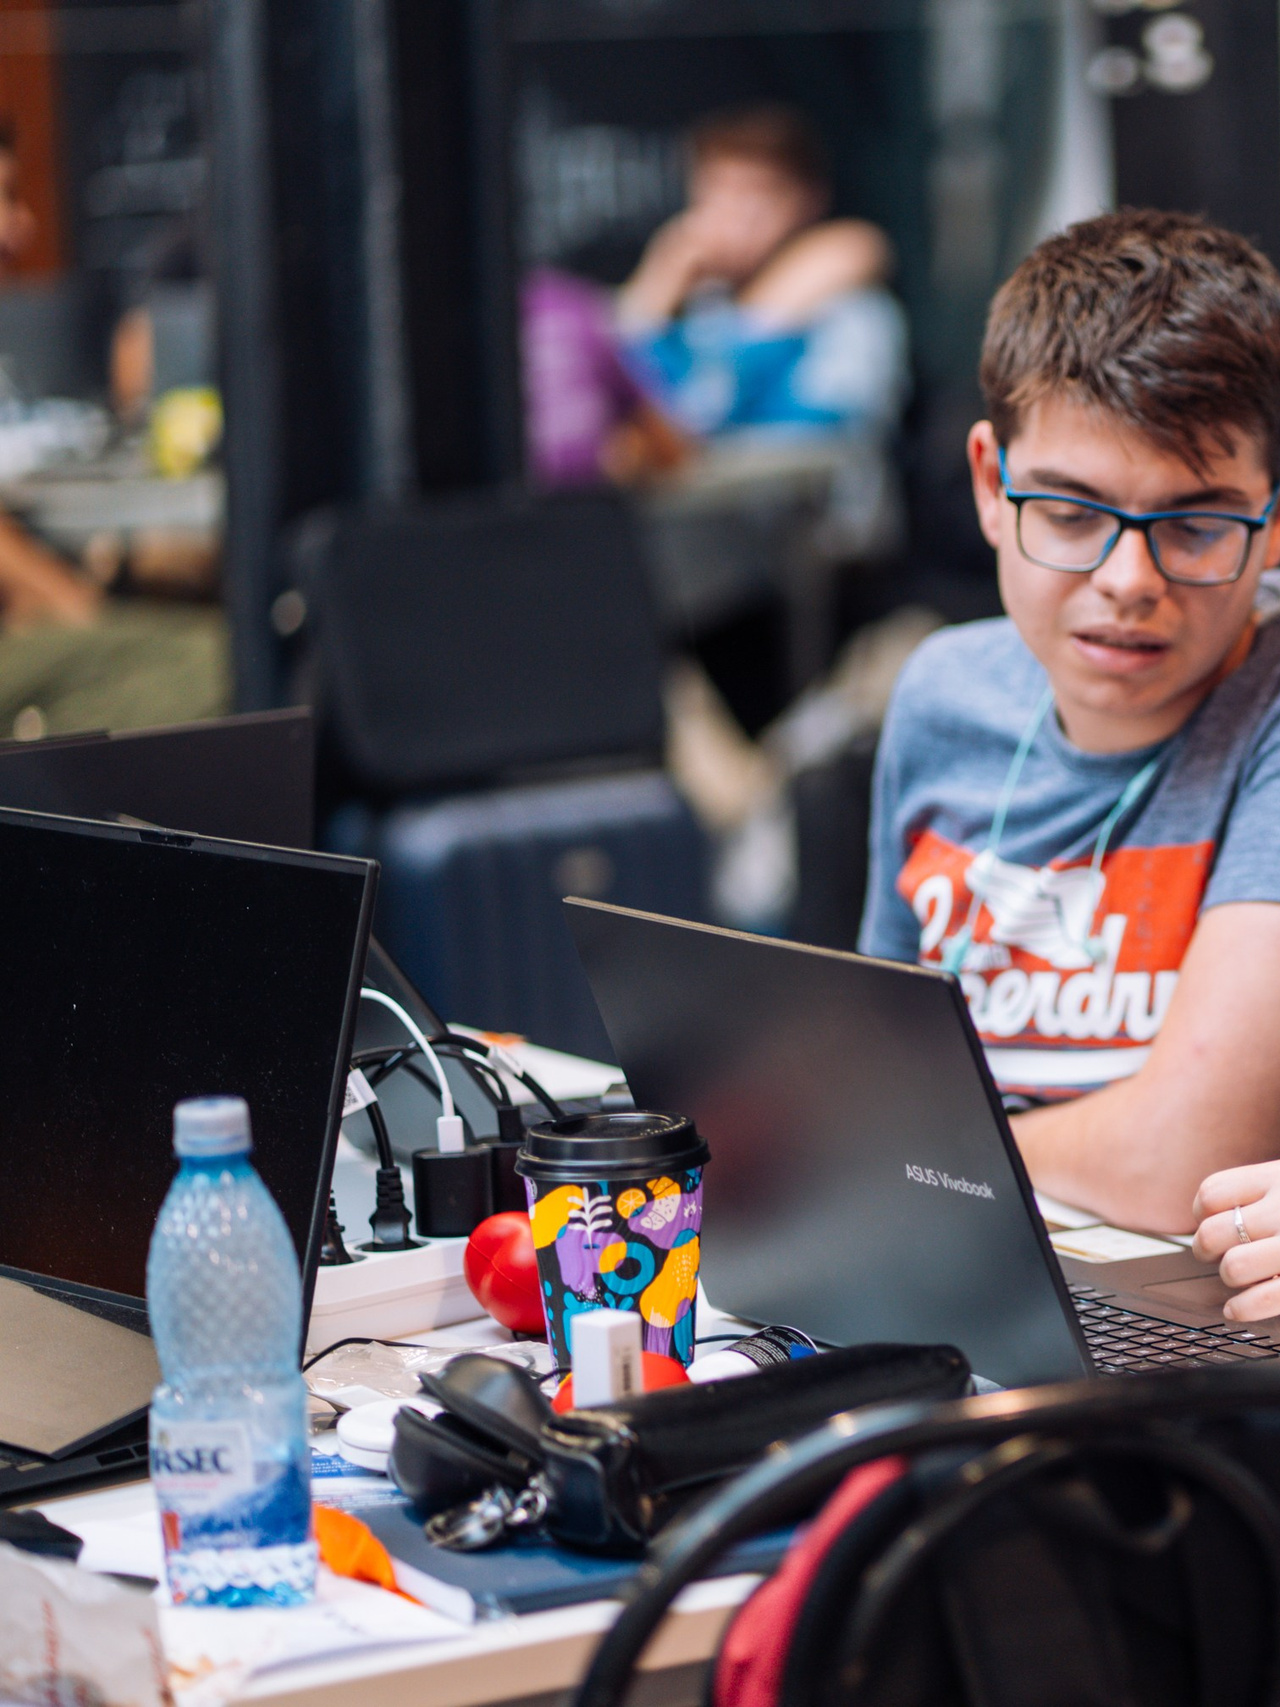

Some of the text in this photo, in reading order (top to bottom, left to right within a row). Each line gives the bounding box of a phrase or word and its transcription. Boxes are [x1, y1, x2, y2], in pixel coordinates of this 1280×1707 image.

[905, 1163, 995, 1200] ASUS Vivobook
[152, 1446, 232, 1475] RSEC
